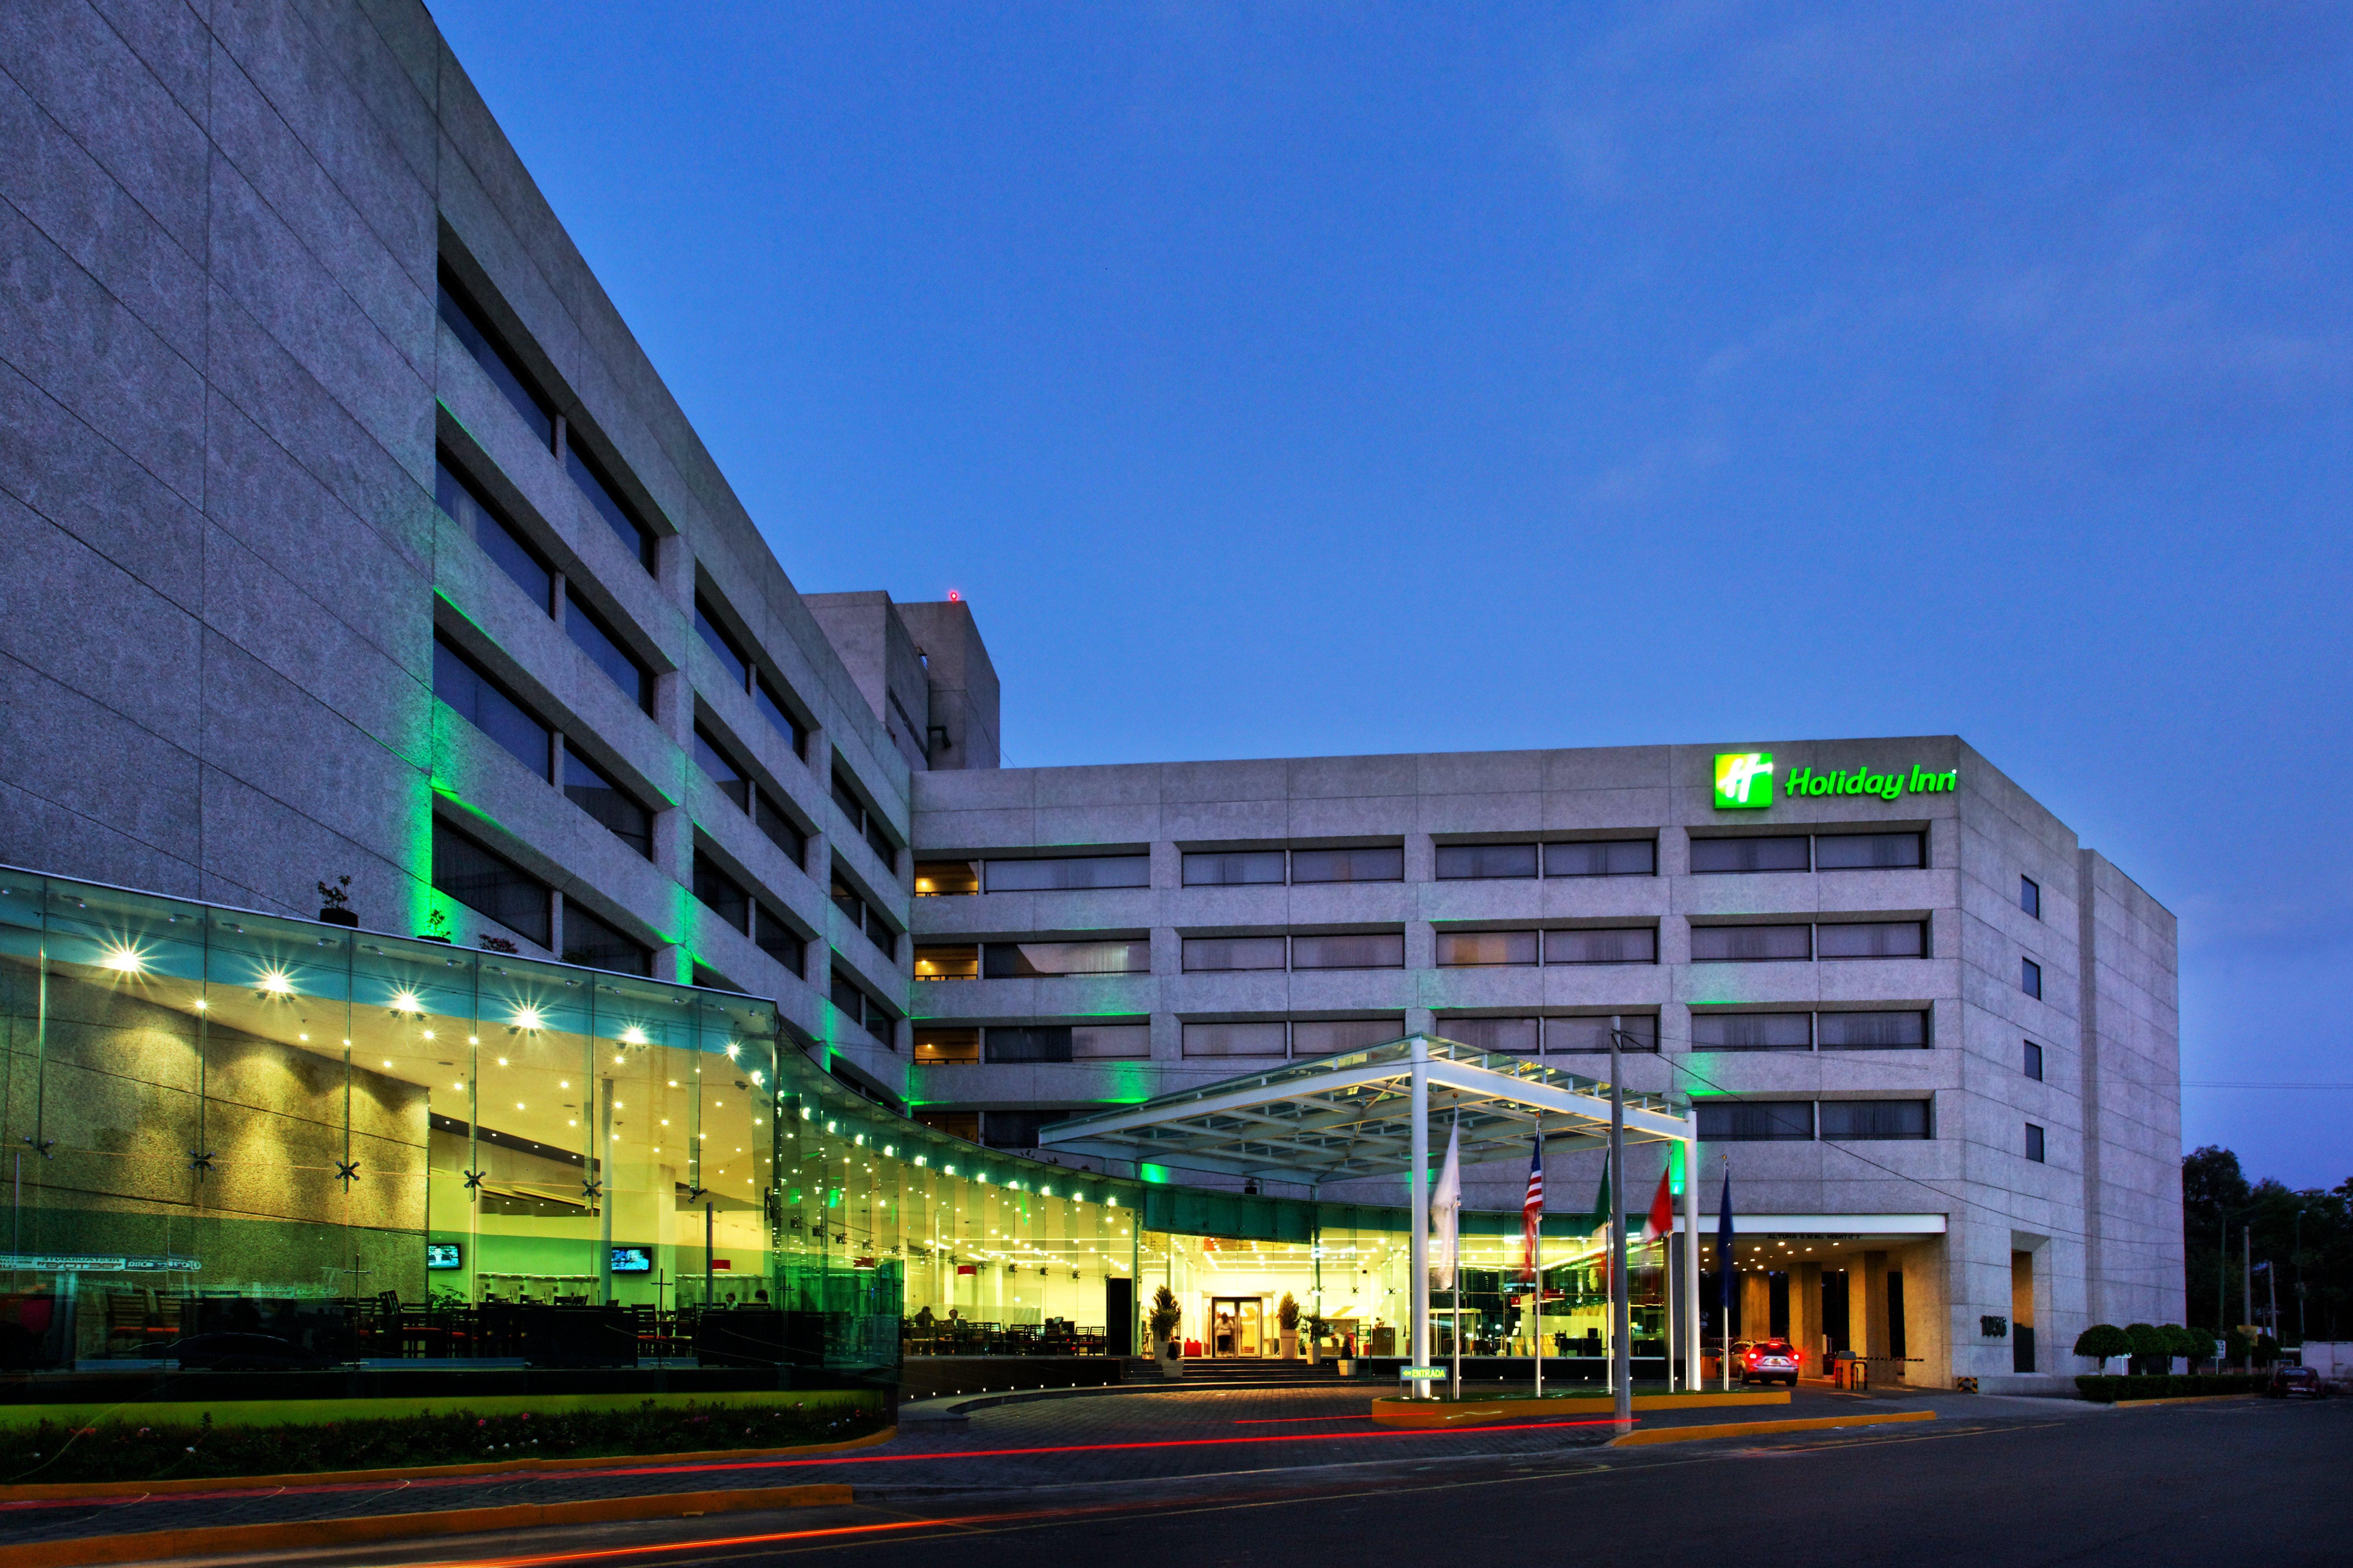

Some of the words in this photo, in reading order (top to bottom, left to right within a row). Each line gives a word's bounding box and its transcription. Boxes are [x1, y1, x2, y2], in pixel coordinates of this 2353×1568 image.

[1785, 766, 1905, 799] Holiday
[1909, 764, 1956, 792] Inn
[1412, 1369, 1445, 1377] ENTRADA
